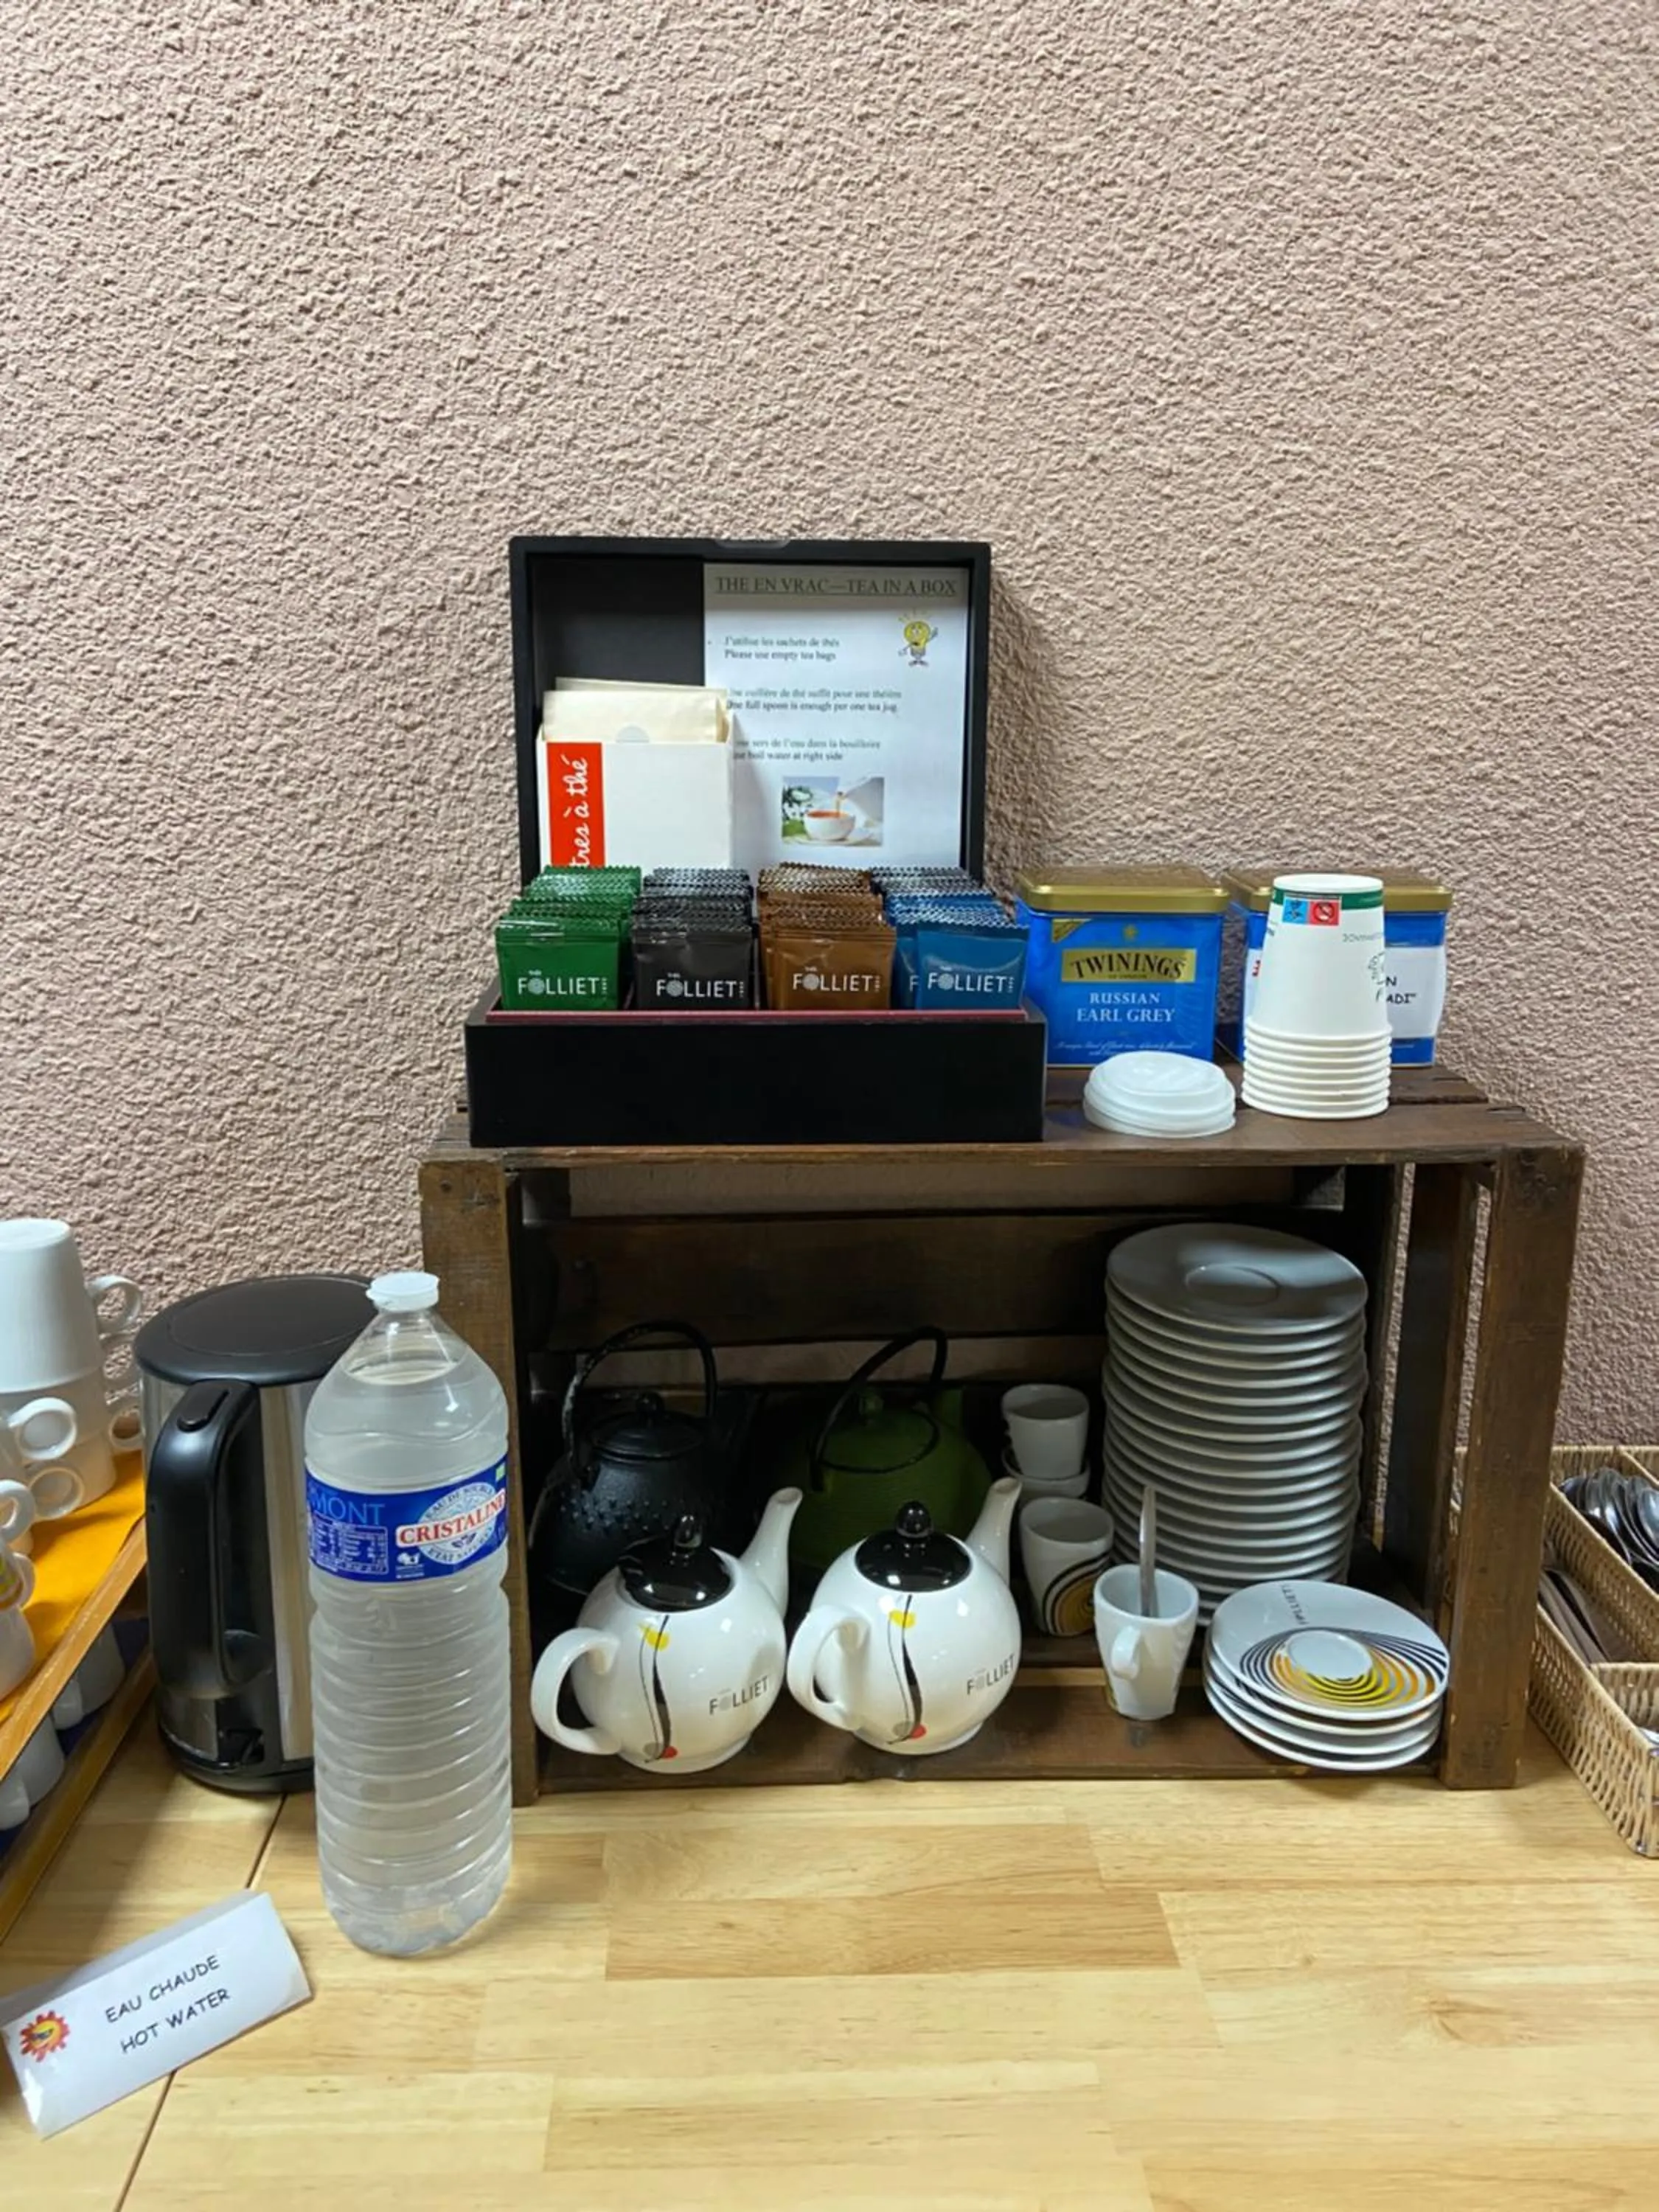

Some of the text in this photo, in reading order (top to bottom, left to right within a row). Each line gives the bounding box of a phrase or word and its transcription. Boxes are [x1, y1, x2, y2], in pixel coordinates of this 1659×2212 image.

[716, 577, 748, 591] THE
[754, 577, 776, 591] EN
[882, 580, 901, 593] IN
[905, 580, 917, 594] A
[921, 580, 957, 596] BOX
[809, 638, 820, 647] de
[724, 650, 752, 658] Please
[771, 651, 798, 661] empty
[800, 652, 814, 660] tea
[815, 650, 836, 662] bags
[745, 700, 760, 709] full
[762, 703, 788, 713] spoon
[799, 702, 832, 712] enough
[833, 703, 847, 713] per
[868, 703, 880, 712] tea
[767, 752, 790, 760] water
[802, 751, 824, 762] right
[825, 752, 843, 761] side
[560, 754, 588, 796] thé
[1071, 952, 1186, 979] TWININGS
[518, 977, 599, 995] FOLLIET
[656, 979, 737, 998] FOLLIET
[793, 973, 873, 992] FOLLIET
[928, 973, 1007, 993] FOLLIET
[1089, 992, 1160, 1004] RUSSIAN
[1077, 1009, 1175, 1023] EARL GREY
[105, 1955, 220, 2023] EAU CHAUDE
[121, 1988, 231, 2053] HOT WATER
